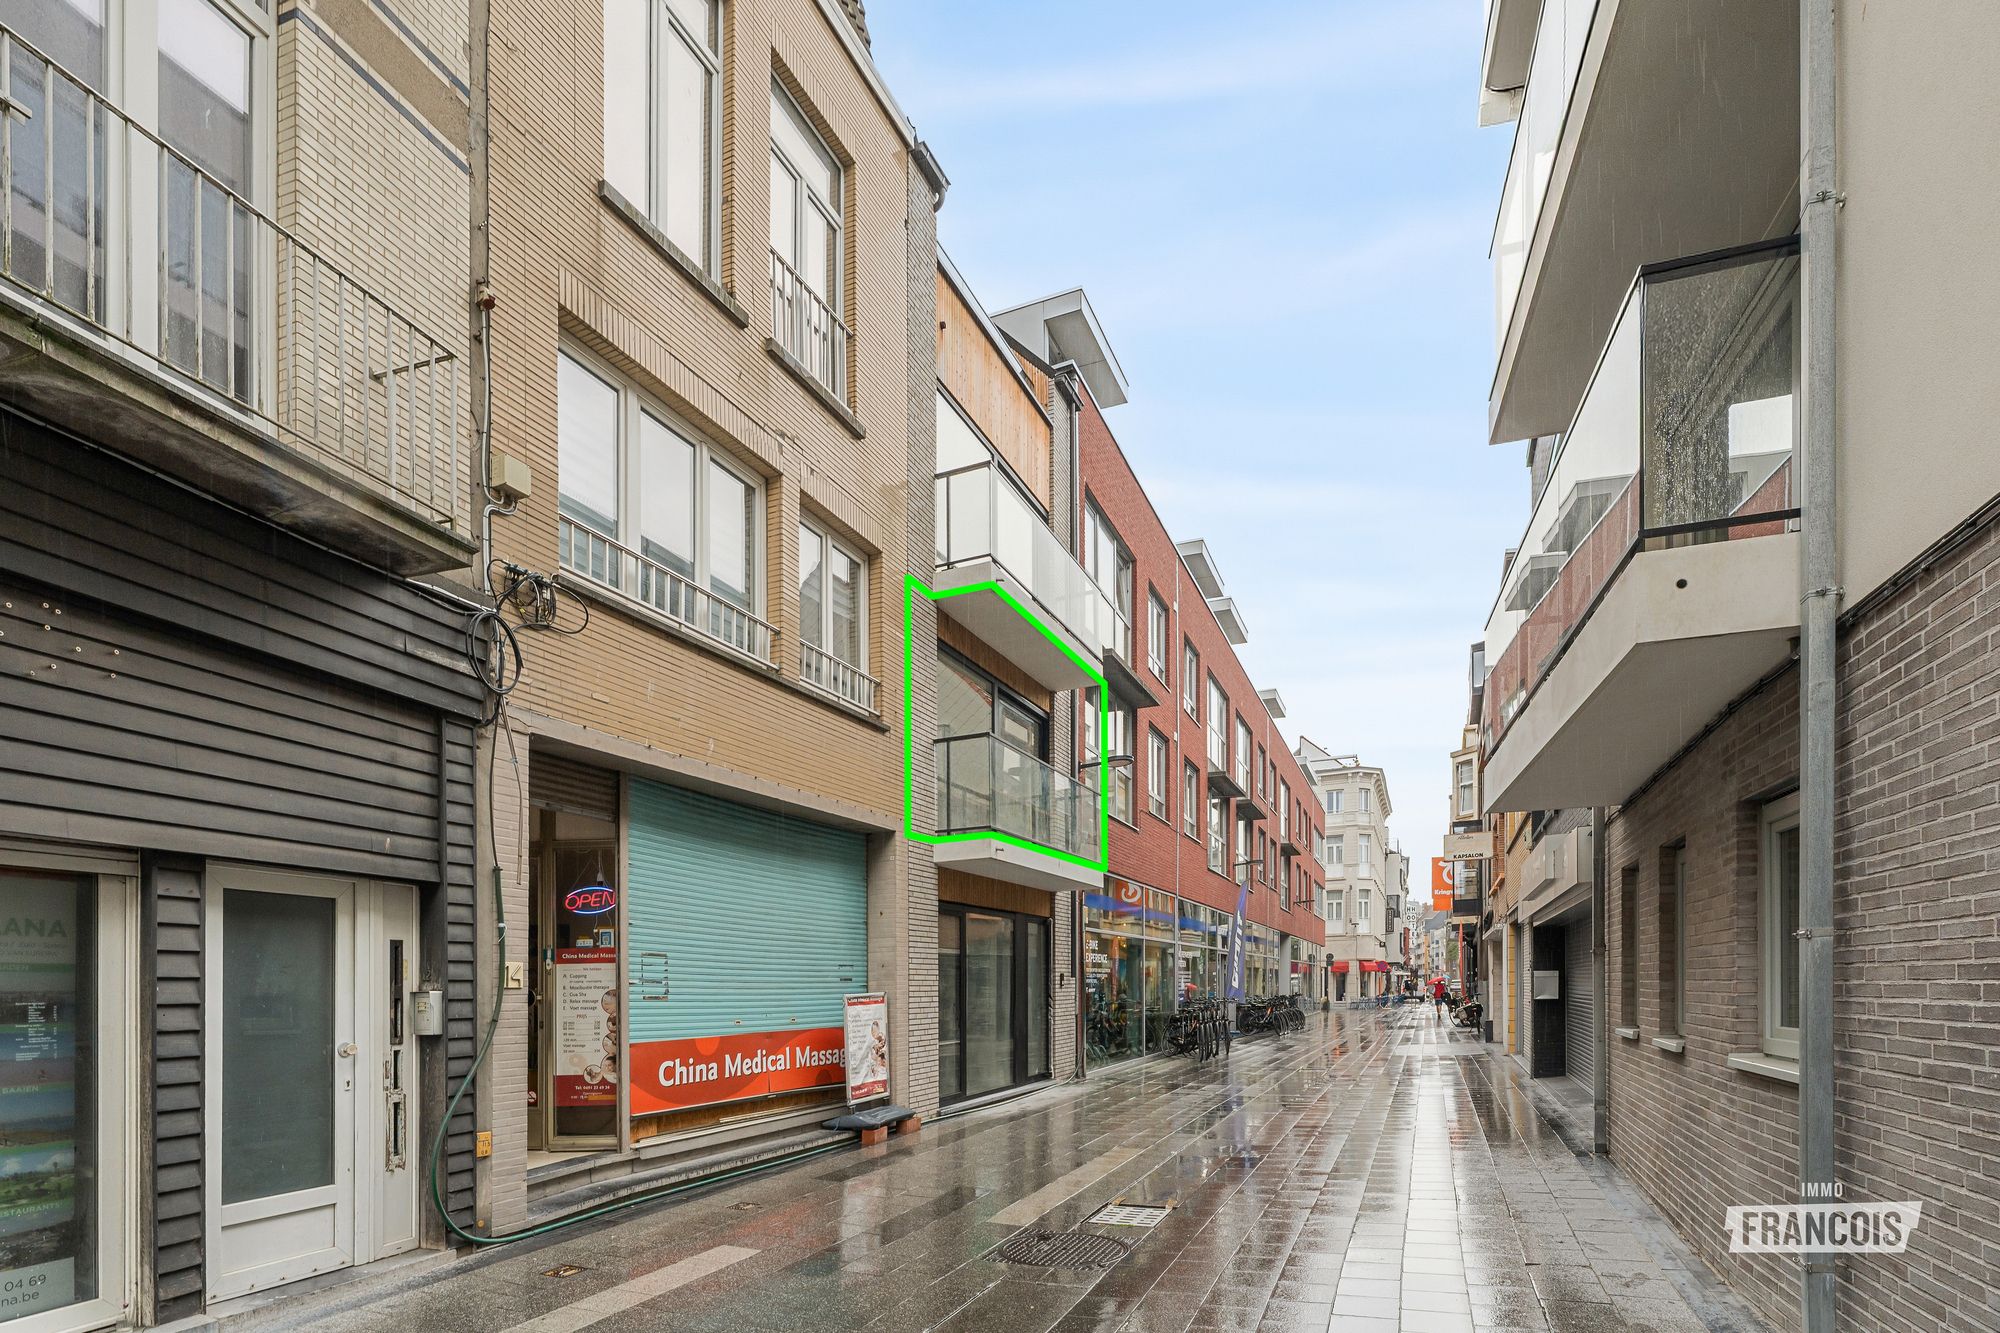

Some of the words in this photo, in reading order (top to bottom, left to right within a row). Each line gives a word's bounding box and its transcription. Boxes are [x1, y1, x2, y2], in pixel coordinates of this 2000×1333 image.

[1453, 852, 1484, 860] KAPSALON
[565, 891, 616, 910] OPEN
[0, 917, 68, 937] ANA
[1086, 953, 1108, 963] EXPERIENCE
[505, 965, 521, 987] 14
[658, 1057, 719, 1088] China
[724, 1047, 791, 1078] Medical
[4, 1279, 23, 1292] 04
[28, 1273, 47, 1287] 69
